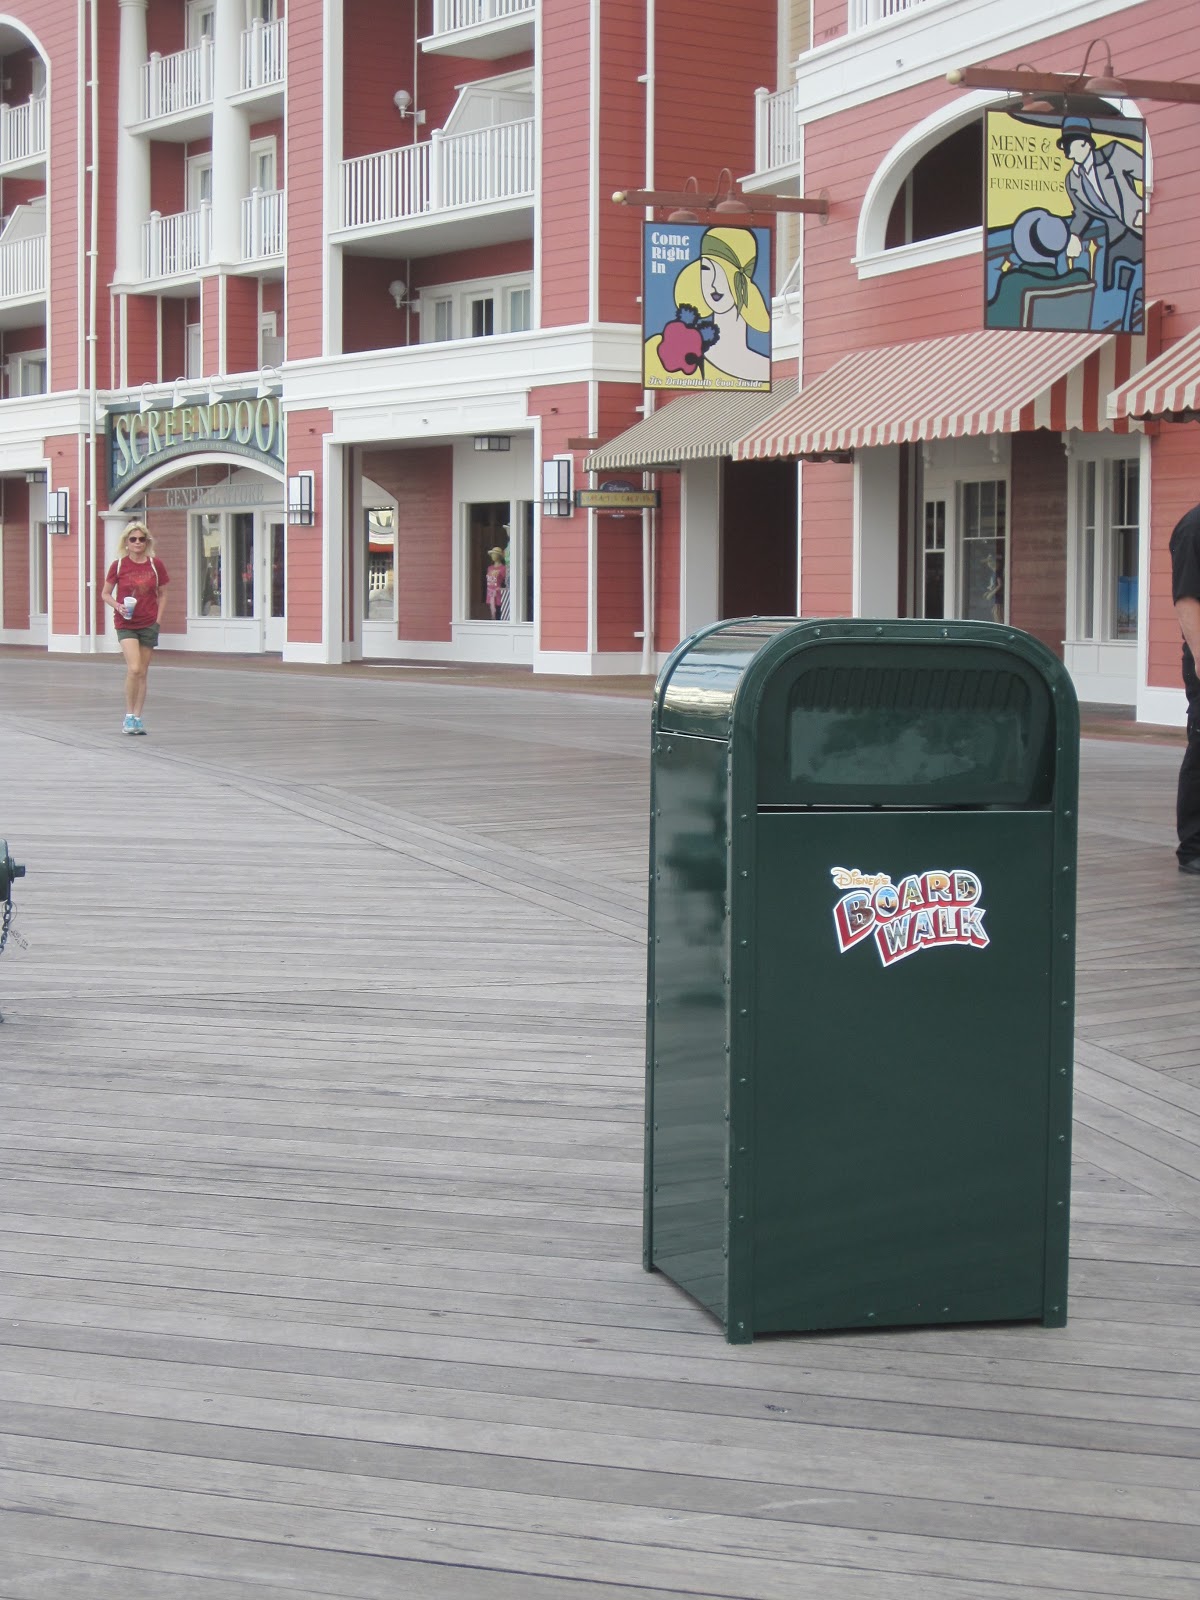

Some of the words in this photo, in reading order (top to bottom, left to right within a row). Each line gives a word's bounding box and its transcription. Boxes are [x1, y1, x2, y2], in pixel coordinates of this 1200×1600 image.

[991, 135, 1037, 153] MEN'S
[1040, 137, 1051, 153] &
[991, 153, 1062, 171] WOMEN'S
[990, 177, 1065, 192] FURNISHINGS
[651, 231, 690, 246] Come
[651, 246, 690, 262] Right
[651, 262, 666, 274] In
[715, 379, 734, 387] Cool
[735, 379, 763, 388] Inside
[836, 868, 889, 890] Disney's
[836, 871, 981, 951] BOARD
[876, 908, 989, 966] WALK
